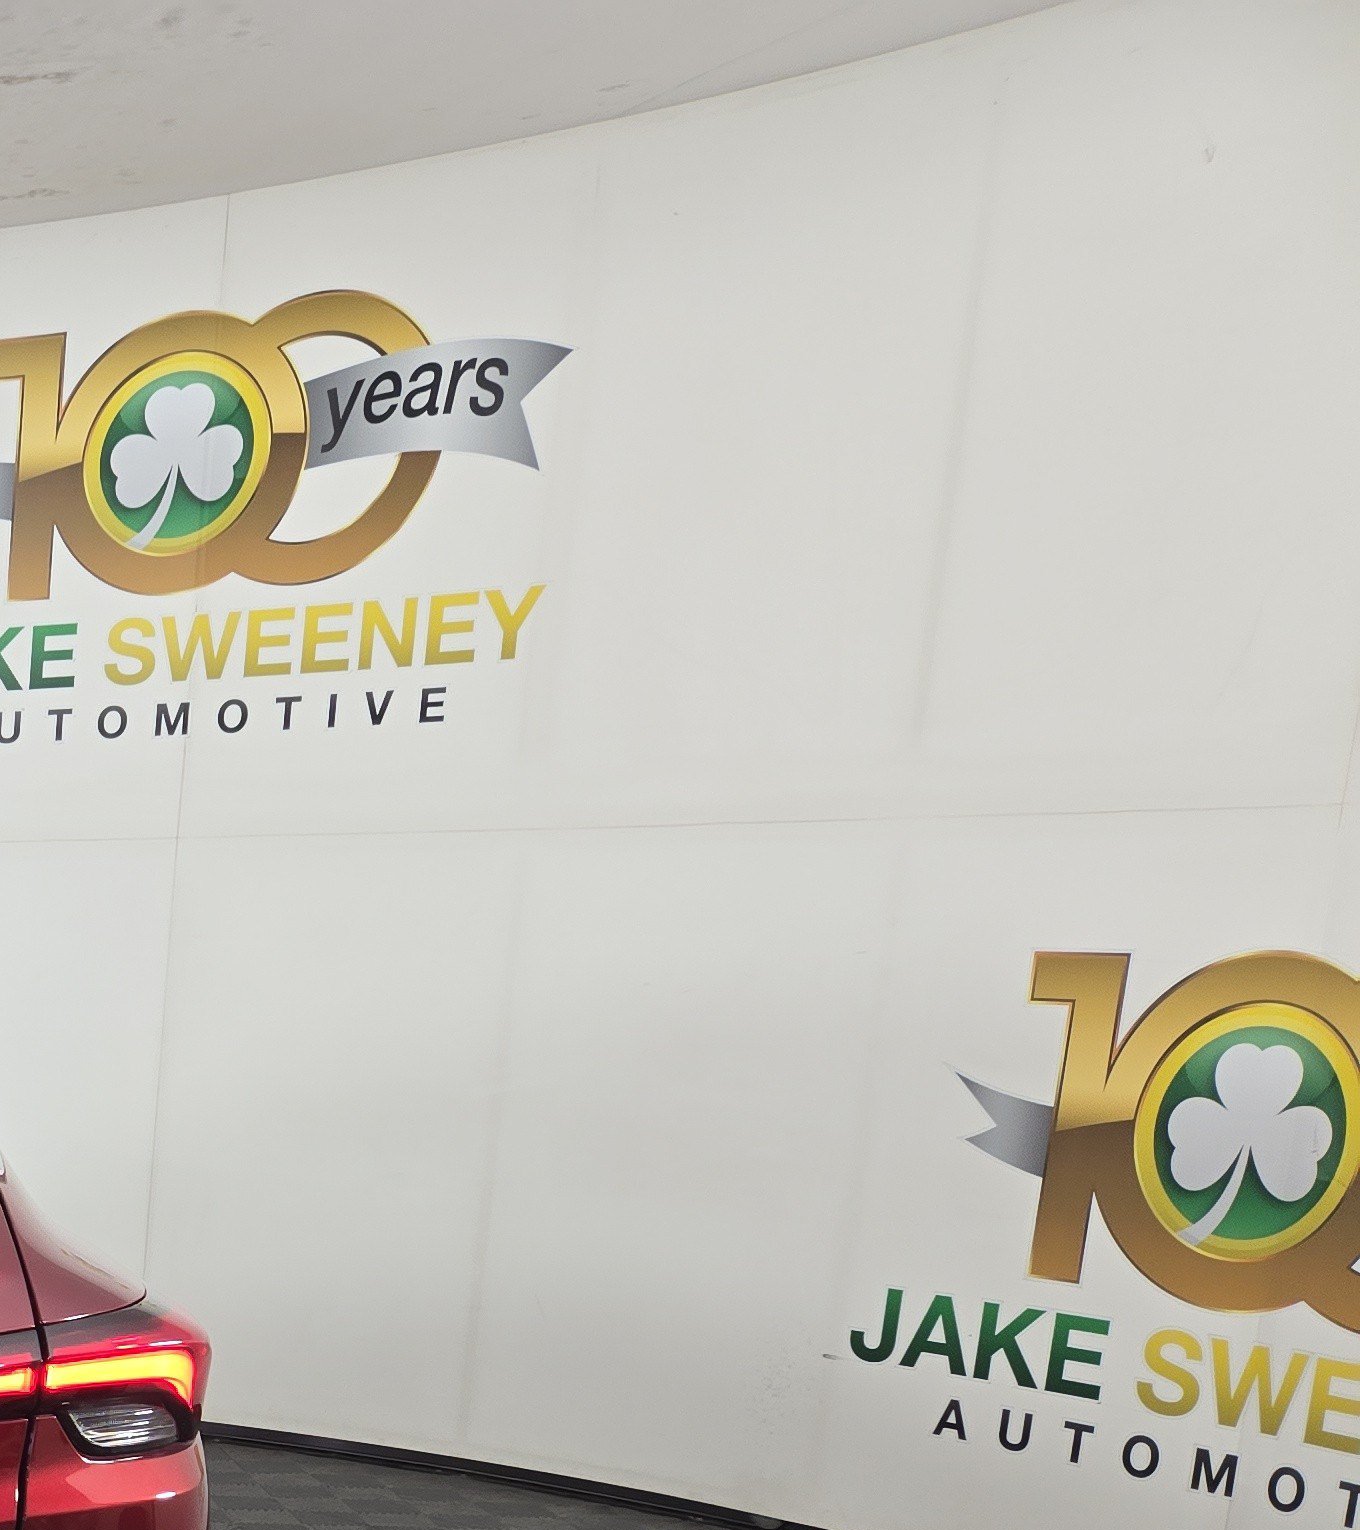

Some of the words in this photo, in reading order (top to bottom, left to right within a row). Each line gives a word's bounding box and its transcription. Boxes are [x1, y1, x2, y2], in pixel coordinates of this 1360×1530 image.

[321, 356, 509, 454] years
[103, 585, 547, 686] SWEENEY
[1028, 950, 1360, 1332] 10
[849, 1287, 1111, 1402] JAKE
[1136, 1328, 1360, 1456] SWE
[932, 1399, 1360, 1530] AUTOMOT
